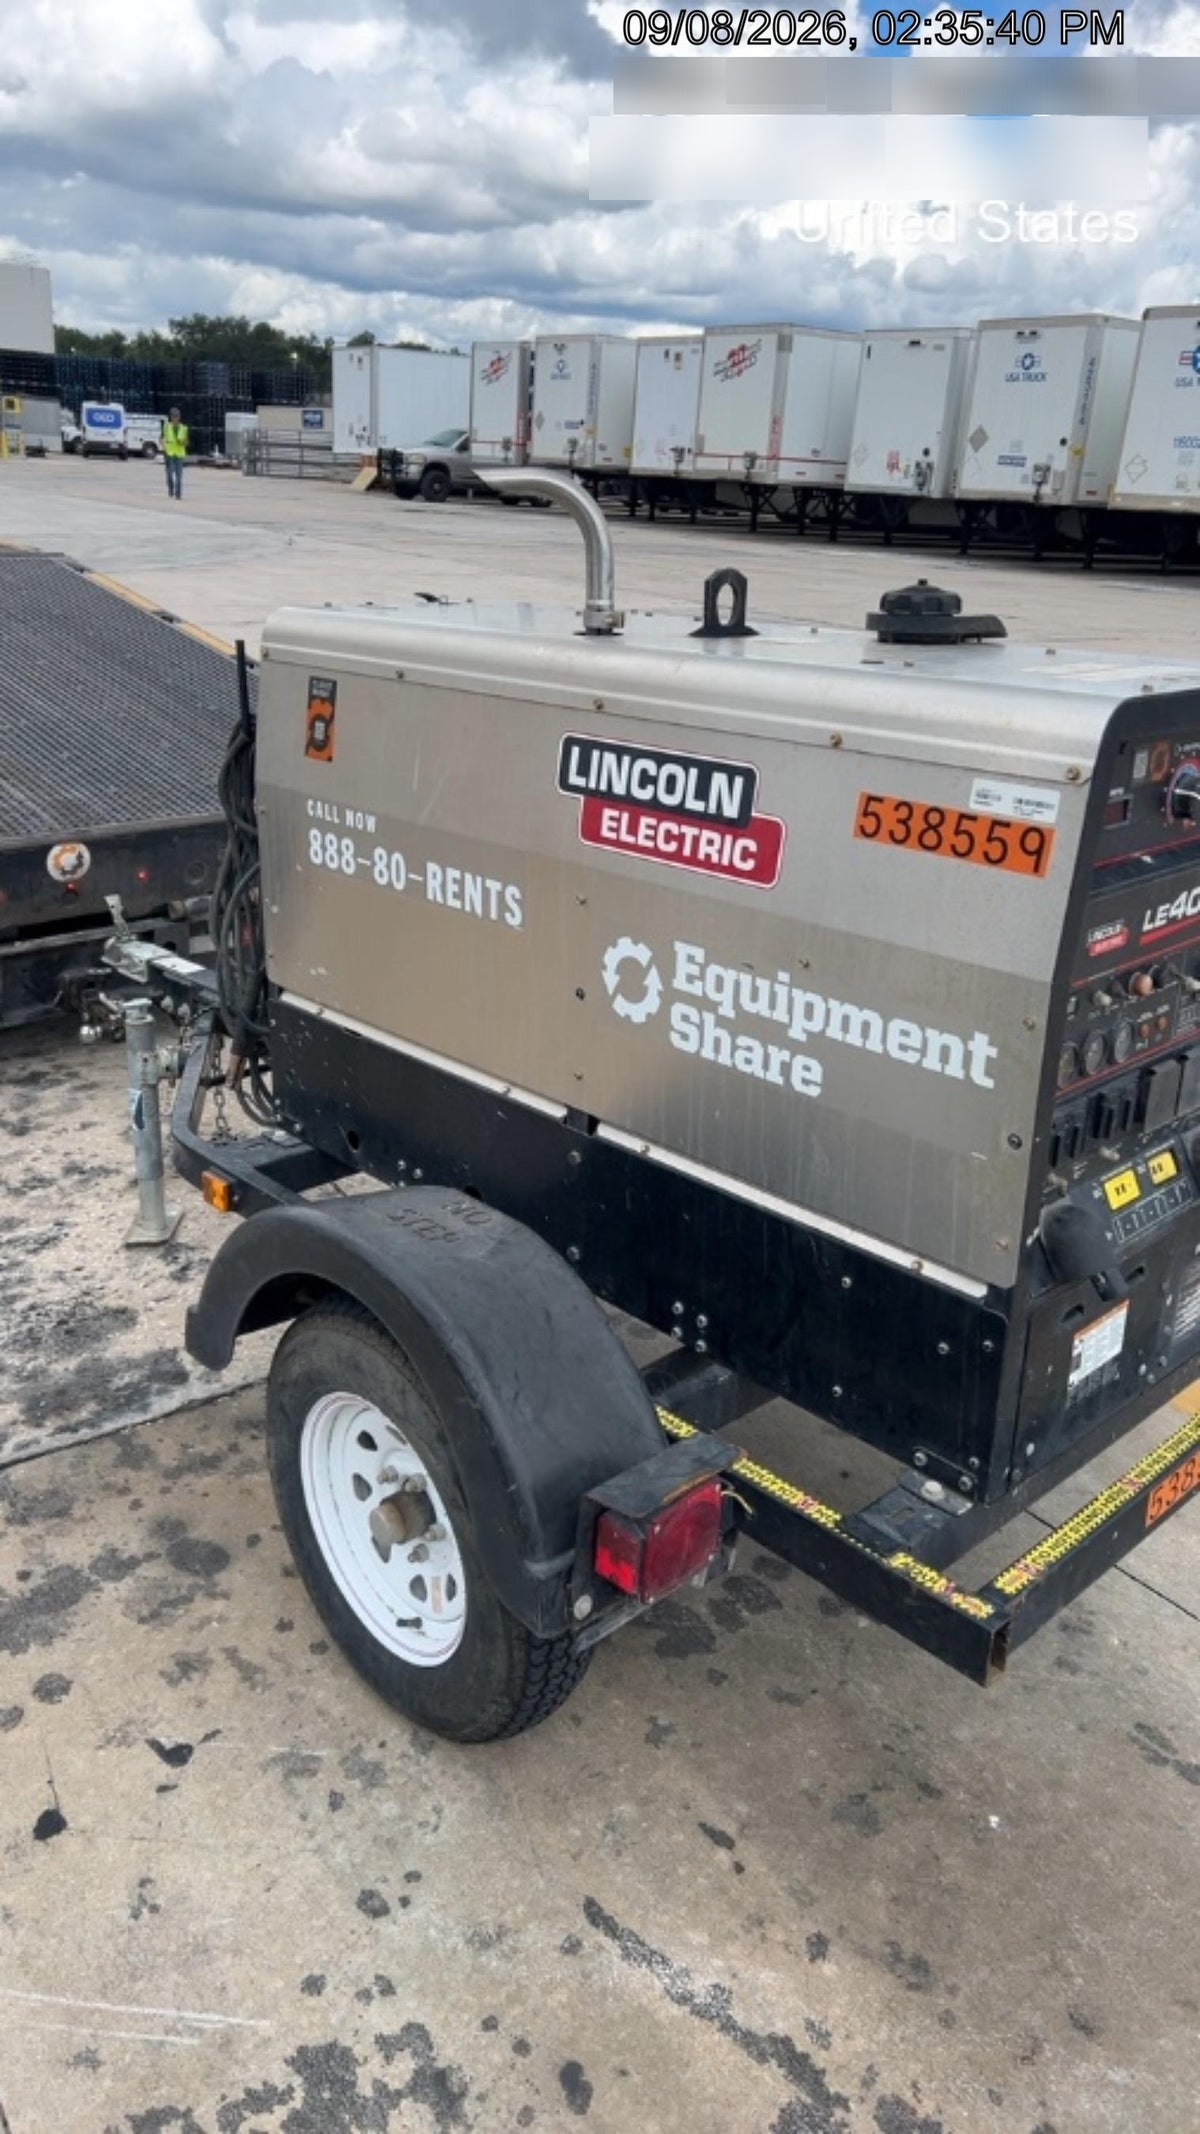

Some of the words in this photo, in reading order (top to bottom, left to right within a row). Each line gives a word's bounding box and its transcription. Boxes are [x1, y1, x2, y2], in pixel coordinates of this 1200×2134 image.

[307, 799, 340, 824] CALL
[345, 808, 377, 833] NOW
[568, 746, 744, 820] LINCOLN
[600, 808, 758, 871] ELECTRIC
[859, 796, 1046, 873] 538559
[308, 828, 524, 927] 888-80-RENTS
[669, 1002, 823, 1097] Share
[672, 940, 998, 1089] Equipment
[1149, 1458, 1200, 1521] 538
